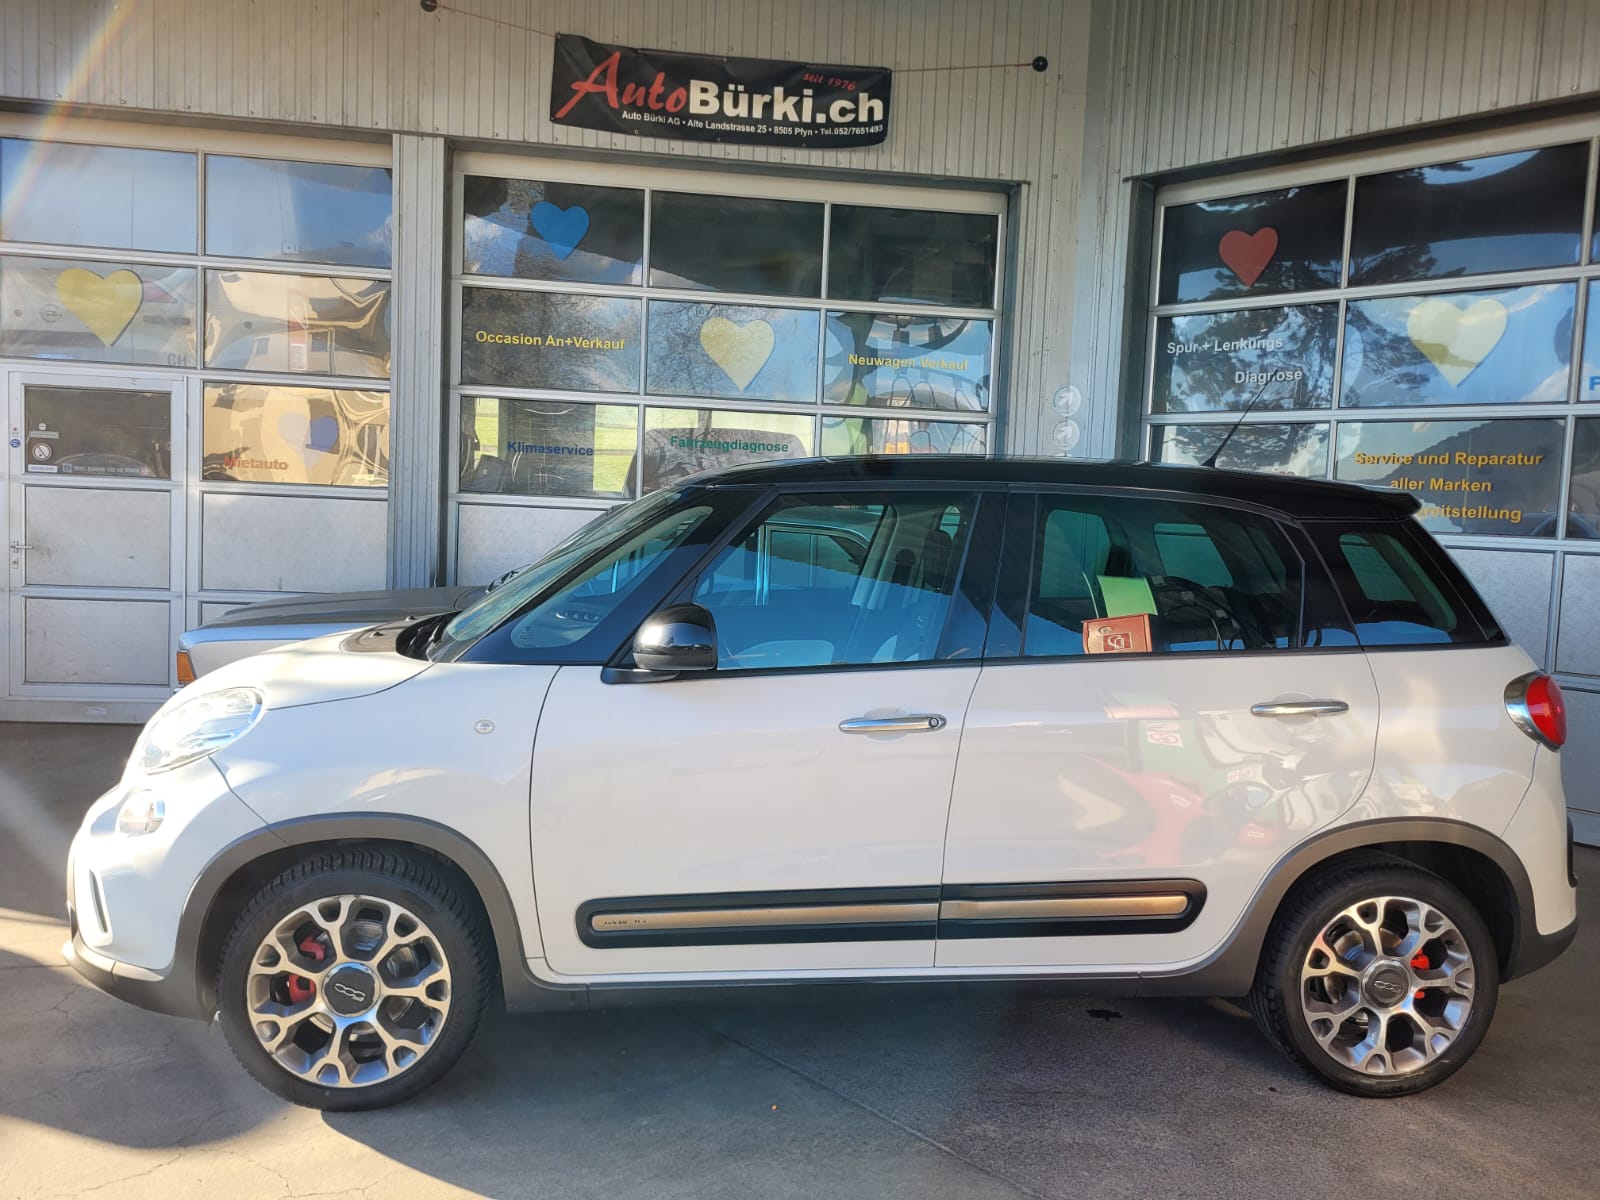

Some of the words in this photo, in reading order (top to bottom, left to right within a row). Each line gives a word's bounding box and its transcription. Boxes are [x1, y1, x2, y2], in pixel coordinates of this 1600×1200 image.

[827, 78, 857, 91] 1976
[622, 110, 642, 121] Auto
[644, 111, 666, 123] Bürki
[668, 117, 681, 126] AG
[687, 118, 704, 129] Alte
[706, 120, 755, 133] Landstrasse
[757, 124, 767, 133] 25
[774, 125, 793, 135] 8505
[795, 127, 813, 138] Pfyn
[476, 330, 541, 346] Occasion
[545, 335, 626, 350] An+Verkauf
[1214, 337, 1284, 352] Lenkungs
[848, 353, 916, 369] Neuwagen
[921, 357, 969, 371] Verkauf
[1235, 370, 1303, 385] Diagnose
[507, 440, 594, 457] Klimaservice
[670, 435, 789, 452] Fahrzeugdiagnose
[224, 455, 289, 470] Mietauto
[1354, 452, 1412, 465] Service
[1418, 452, 1449, 465] und
[1455, 452, 1544, 468] Reparatur
[1391, 477, 1425, 491] aller
[1430, 478, 1492, 492] Marken
